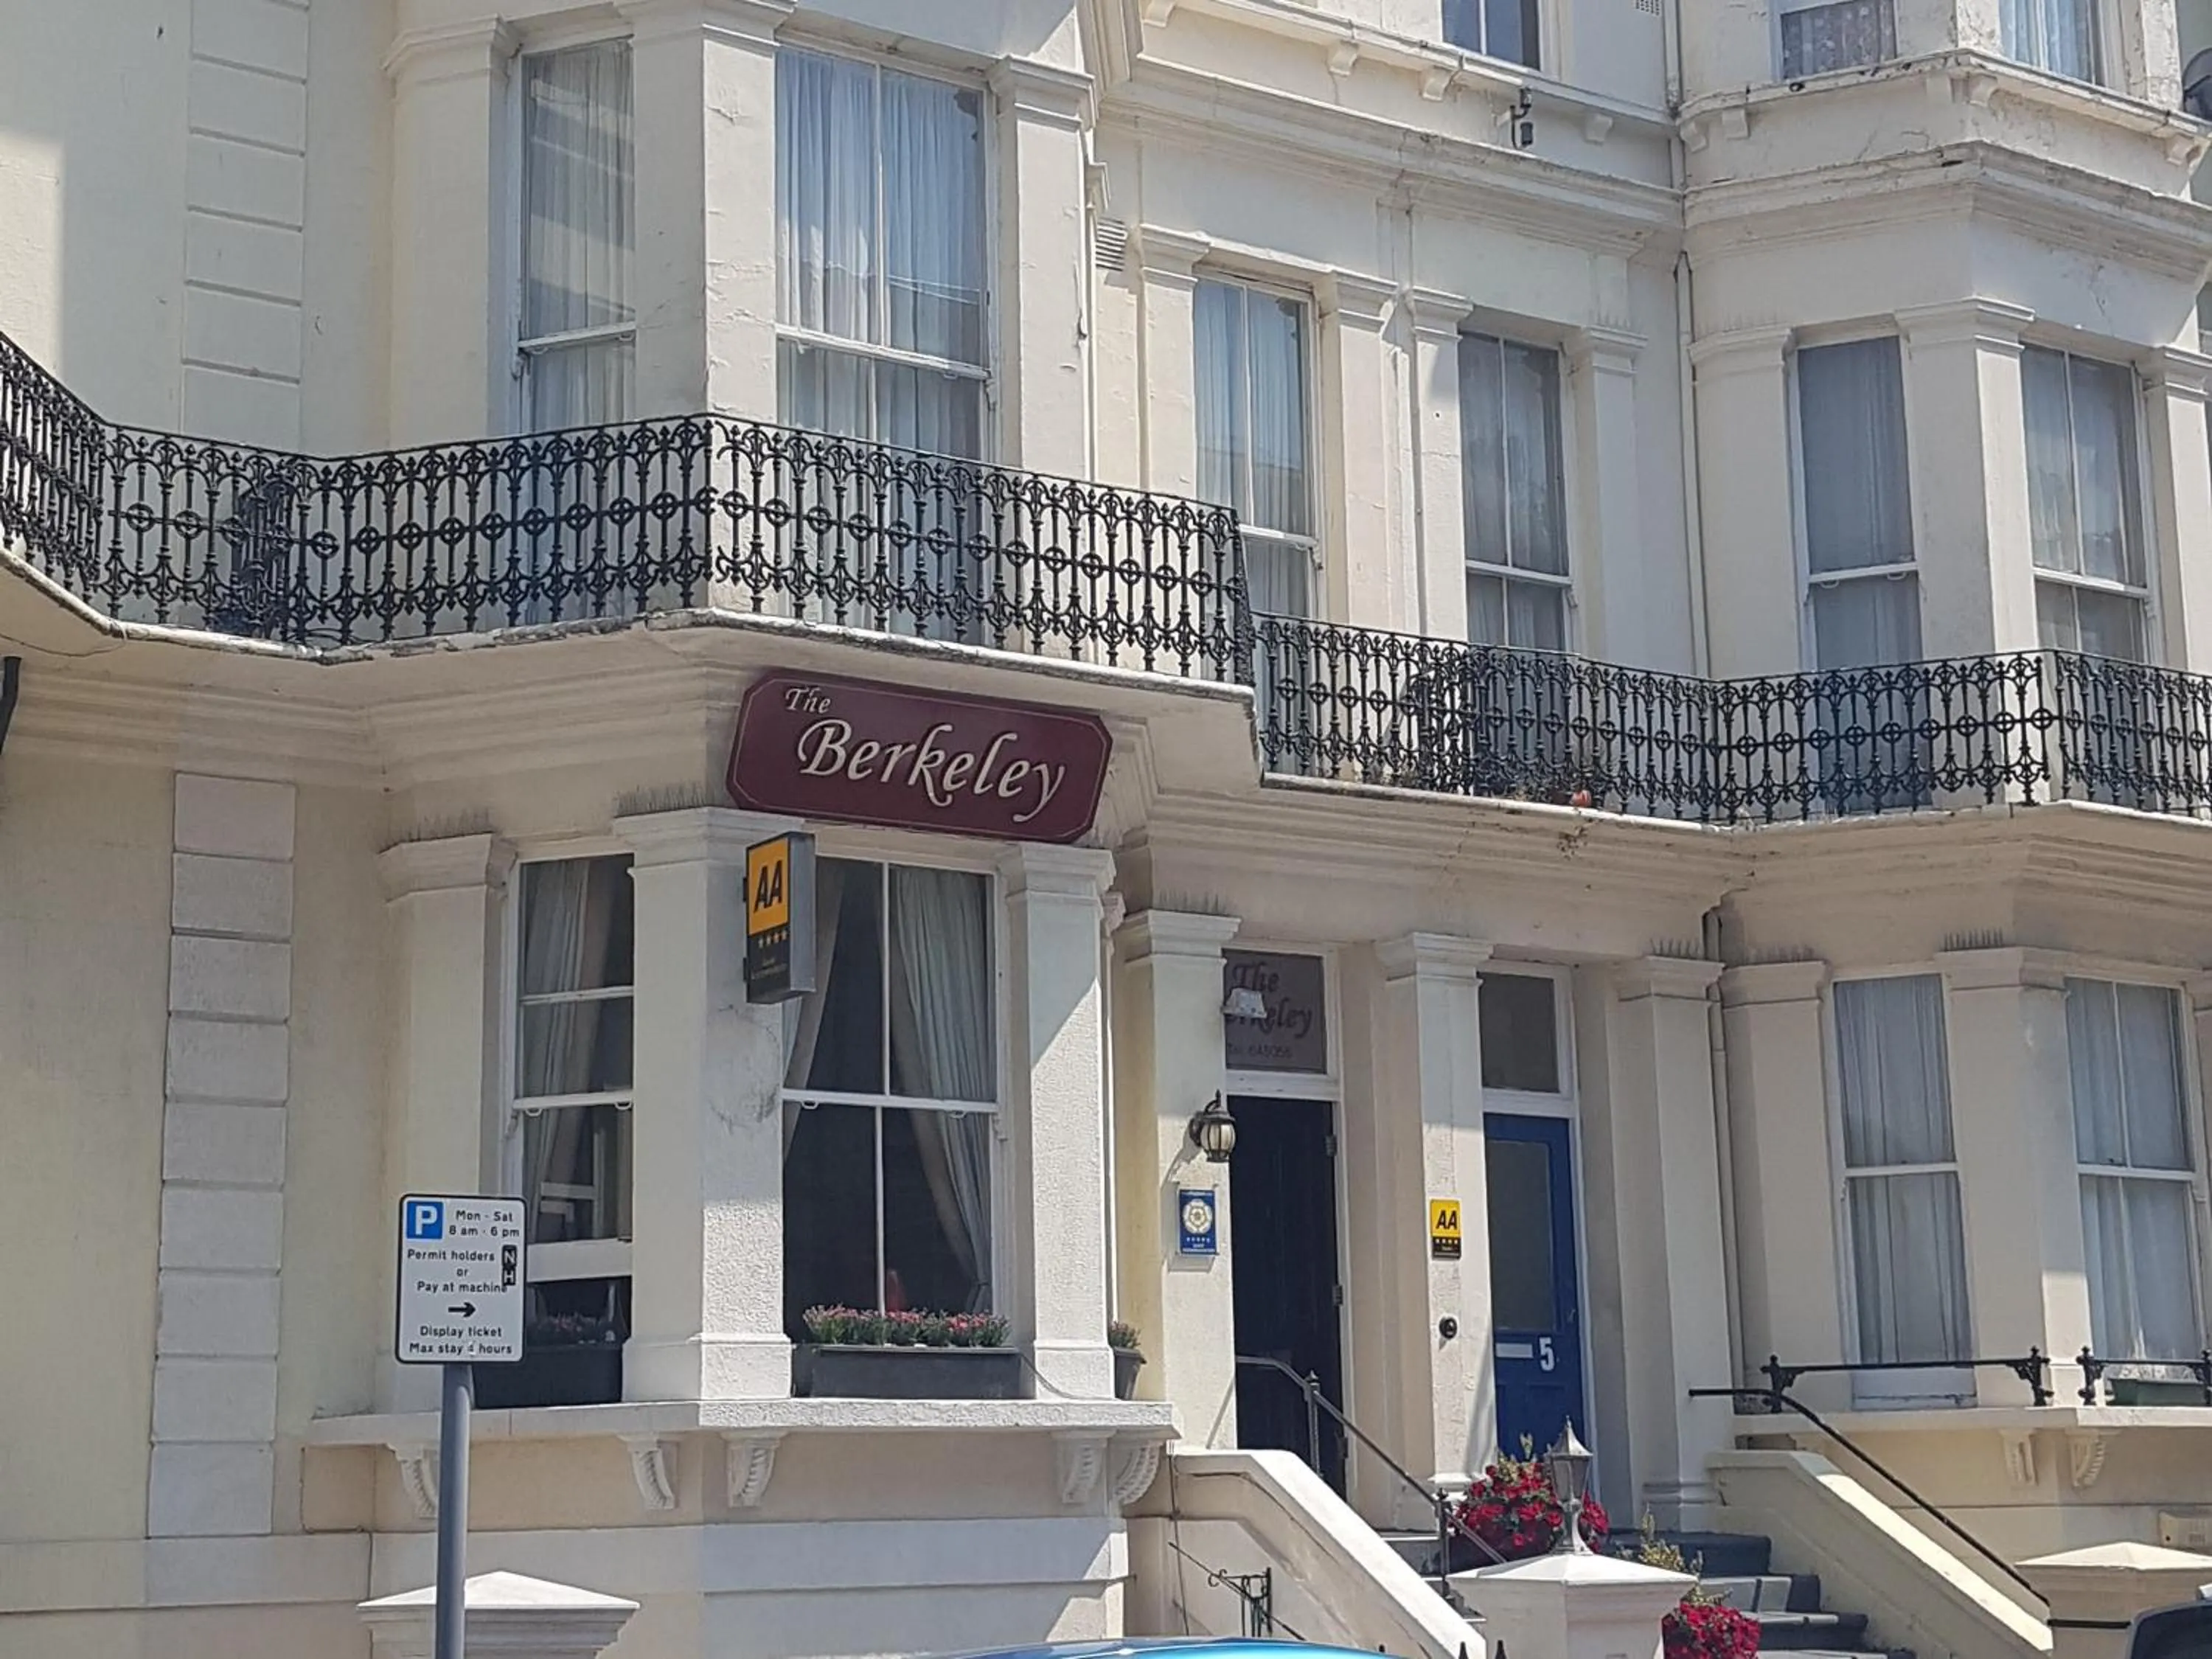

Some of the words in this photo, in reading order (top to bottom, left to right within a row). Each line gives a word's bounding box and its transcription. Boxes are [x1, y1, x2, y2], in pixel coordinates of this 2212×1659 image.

[785, 686, 831, 714] The
[797, 719, 1065, 823] Berkeley
[754, 860, 782, 914] AA
[1232, 961, 1279, 992] The
[415, 1206, 438, 1236] P
[456, 1210, 481, 1221] Mon
[493, 1211, 513, 1222] Sat
[1436, 1209, 1458, 1230] AA
[449, 1225, 456, 1235] 8
[461, 1227, 478, 1236] am
[490, 1226, 498, 1237] 6
[502, 1228, 520, 1238] pm
[407, 1248, 447, 1260] Permit
[451, 1250, 495, 1262] holders
[456, 1268, 469, 1277] or
[417, 1281, 439, 1293] Pay
[442, 1282, 454, 1292] at
[459, 1282, 507, 1293] machine
[420, 1326, 464, 1338] Display
[468, 1326, 502, 1337] ticket
[409, 1343, 433, 1353] Max
[438, 1343, 464, 1355] stay
[479, 1343, 512, 1354] hours
[1539, 1337, 1555, 1371] 5
